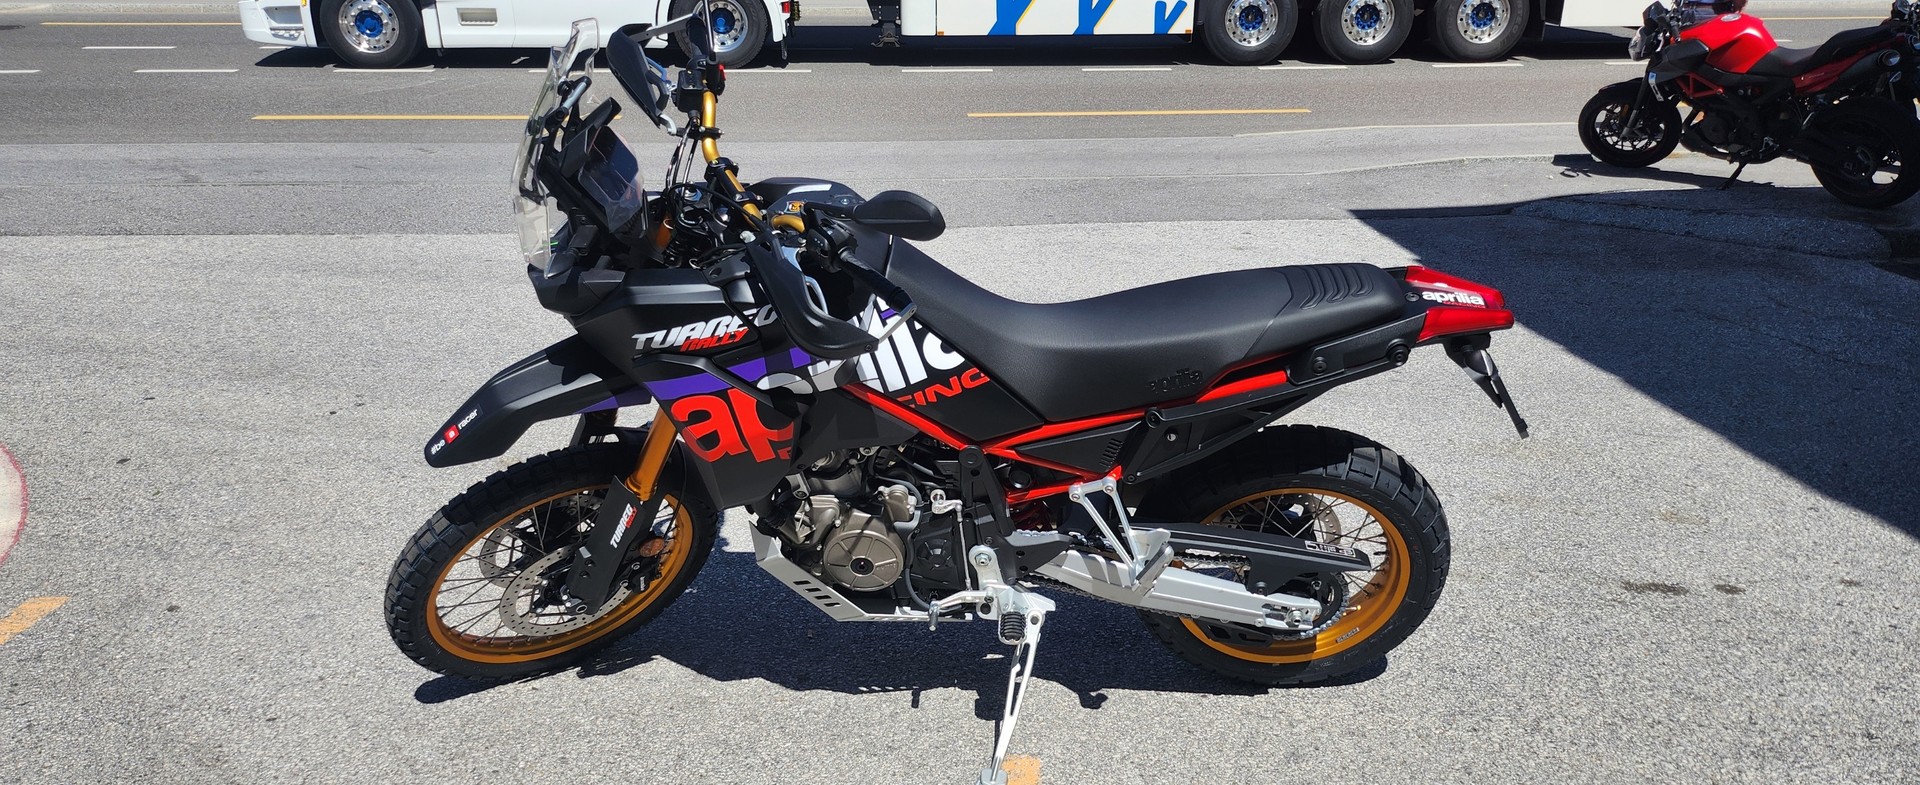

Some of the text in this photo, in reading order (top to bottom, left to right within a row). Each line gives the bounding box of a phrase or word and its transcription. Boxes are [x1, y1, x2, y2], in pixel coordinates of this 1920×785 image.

[1421, 291, 1485, 306] aprilia
[680, 327, 750, 352] RALLY
[430, 439, 446, 455] #be
[458, 408, 478, 430] racer
